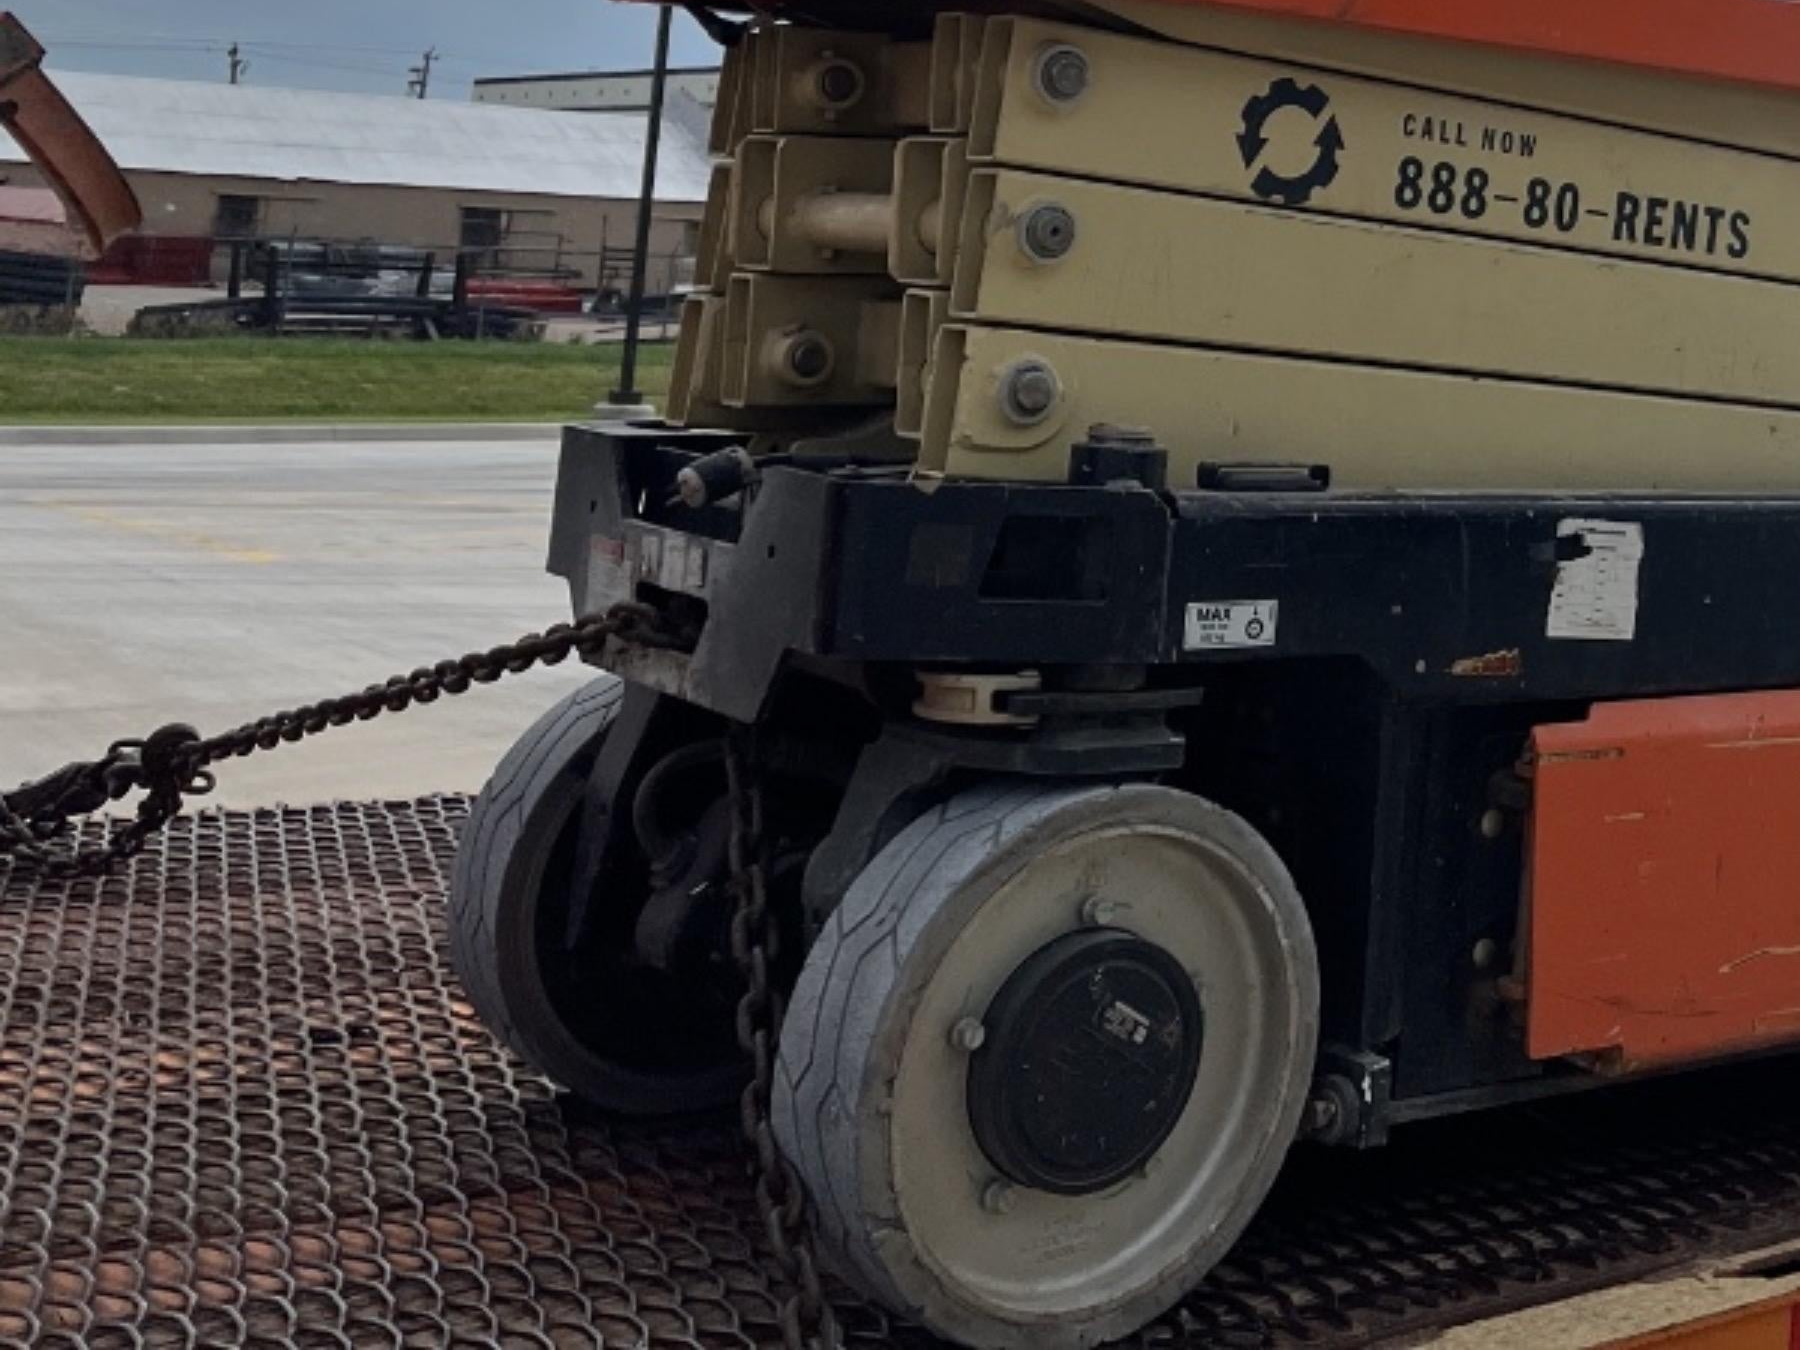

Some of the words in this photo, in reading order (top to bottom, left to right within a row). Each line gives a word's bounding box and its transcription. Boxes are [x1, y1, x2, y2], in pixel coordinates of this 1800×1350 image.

[1403, 113, 1467, 147] CALL
[1481, 125, 1537, 157] NOW
[1394, 155, 1751, 259] 888-80-RENTS
